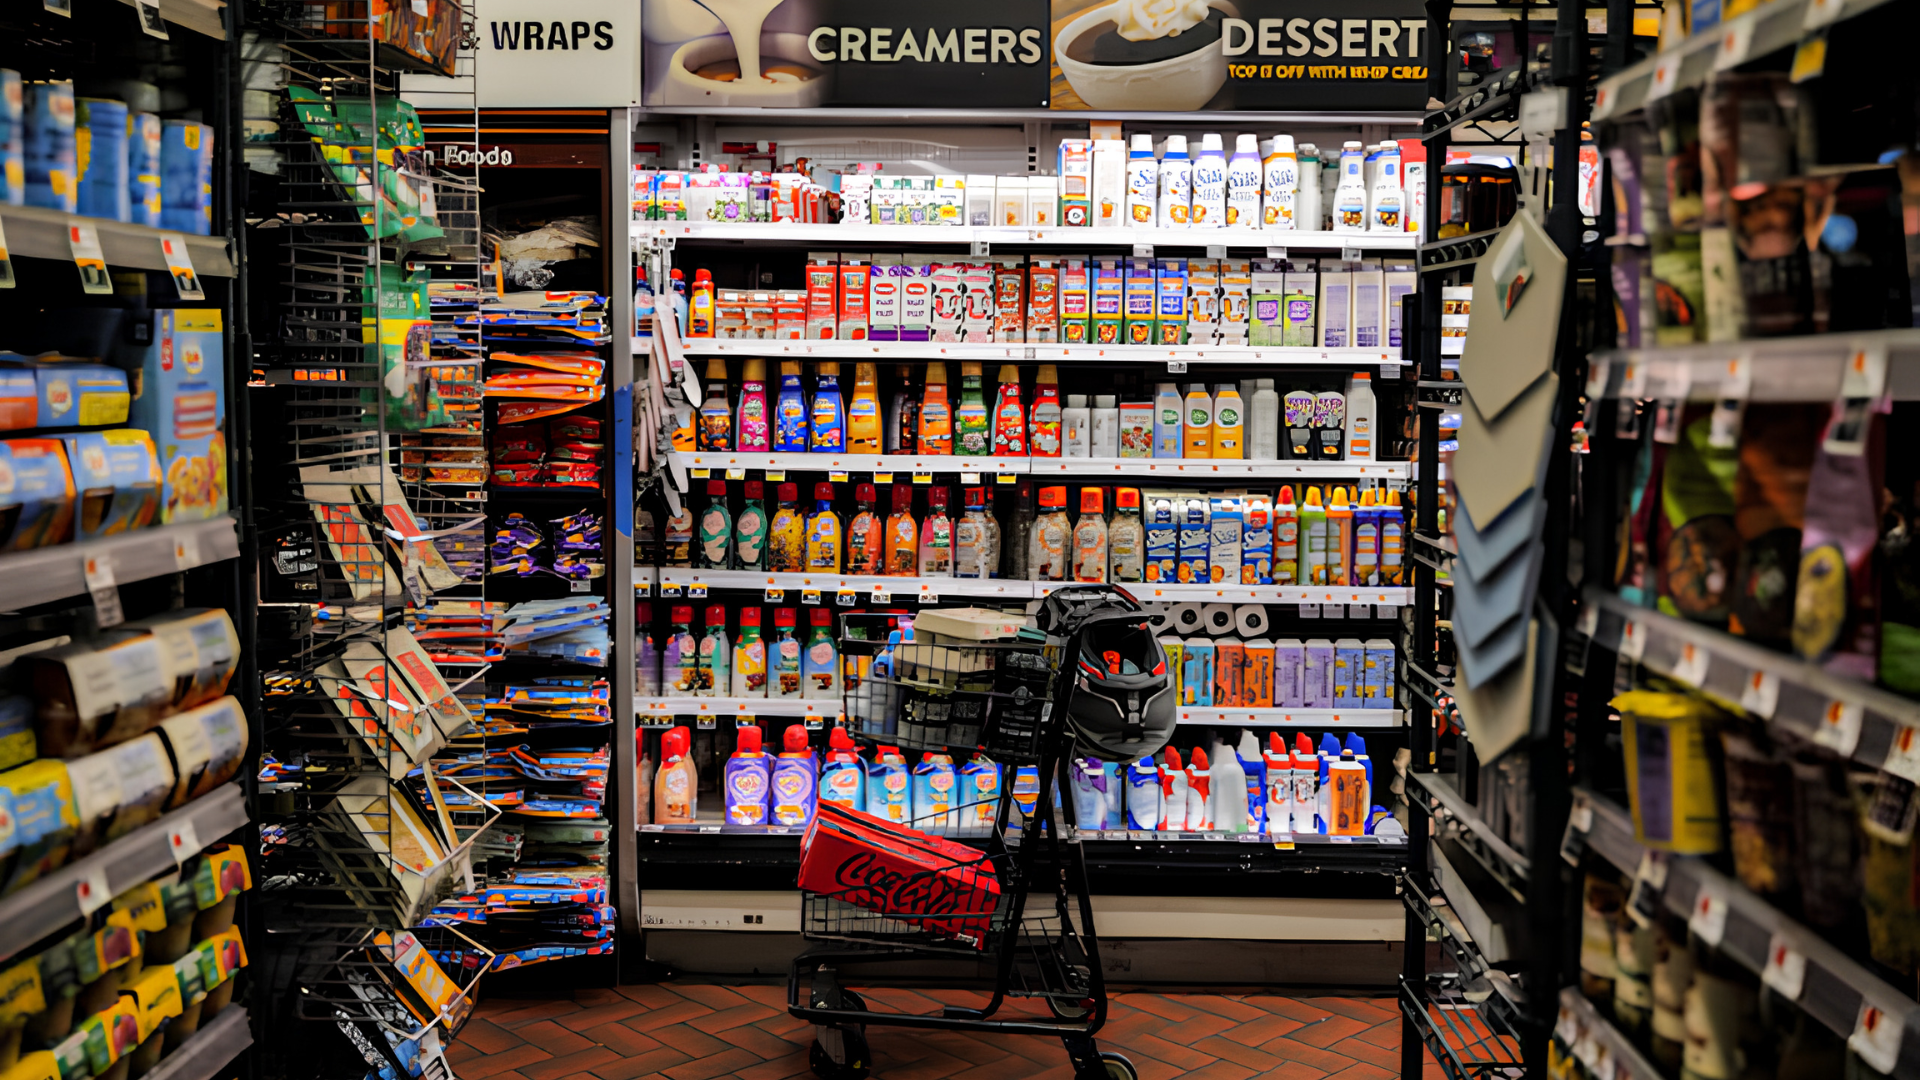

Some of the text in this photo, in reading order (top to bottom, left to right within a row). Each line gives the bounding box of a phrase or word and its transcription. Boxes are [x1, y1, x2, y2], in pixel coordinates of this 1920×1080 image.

[491, 21, 613, 50] WRAPS
[807, 26, 1041, 64] CREAMERS
[1221, 18, 1427, 57] DESSERT
